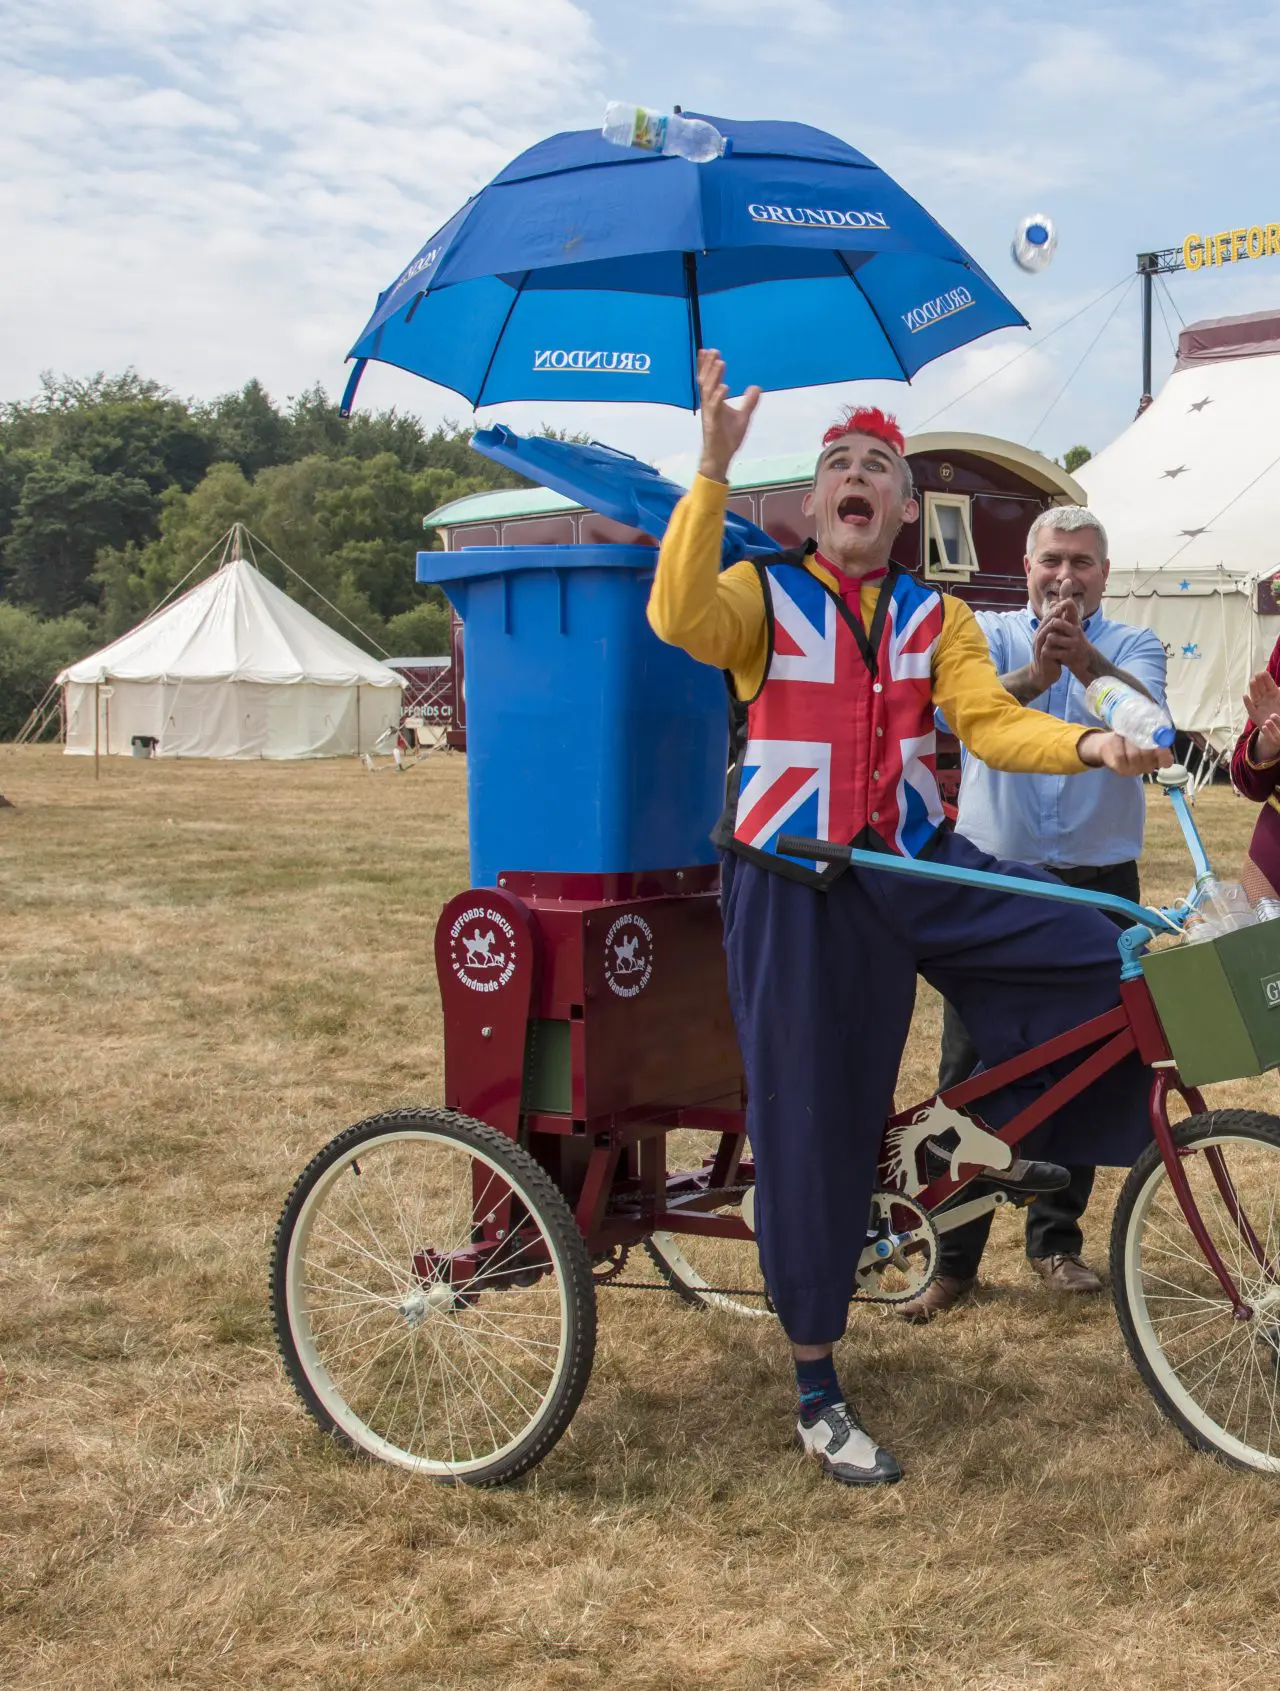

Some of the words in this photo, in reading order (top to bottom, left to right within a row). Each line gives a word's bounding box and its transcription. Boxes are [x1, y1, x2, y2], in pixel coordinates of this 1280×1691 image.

[748, 204, 887, 226] GRUNDON
[450, 907, 485, 938] GIFFORDS
[486, 909, 515, 938] CIRCUS
[605, 913, 632, 946] GIFFORDS
[633, 915, 653, 942] CIRCUS
[452, 962, 460, 970] a
[457, 968, 499, 992] handmade
[499, 961, 516, 985] show
[607, 976, 640, 997] handmade
[640, 964, 653, 989] show
